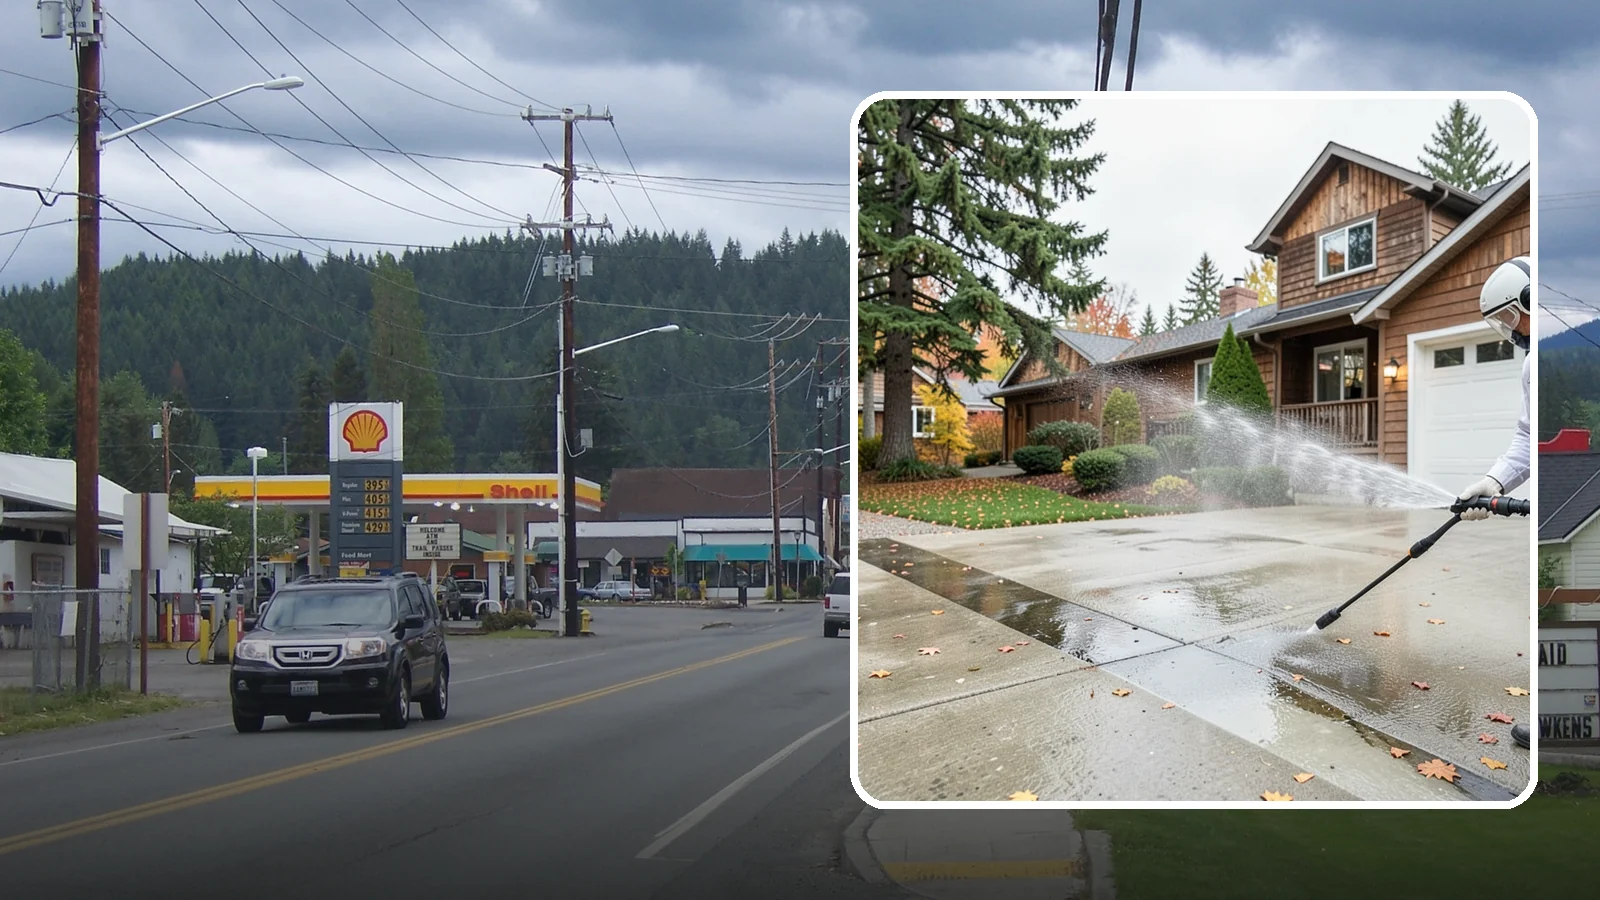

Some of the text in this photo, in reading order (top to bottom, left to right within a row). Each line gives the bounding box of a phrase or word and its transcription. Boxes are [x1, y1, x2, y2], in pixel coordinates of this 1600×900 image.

[366, 480, 383, 490] 395
[490, 484, 547, 499] Shell
[366, 494, 383, 504] 405
[366, 508, 383, 518] 415
[366, 523, 383, 532] 429
